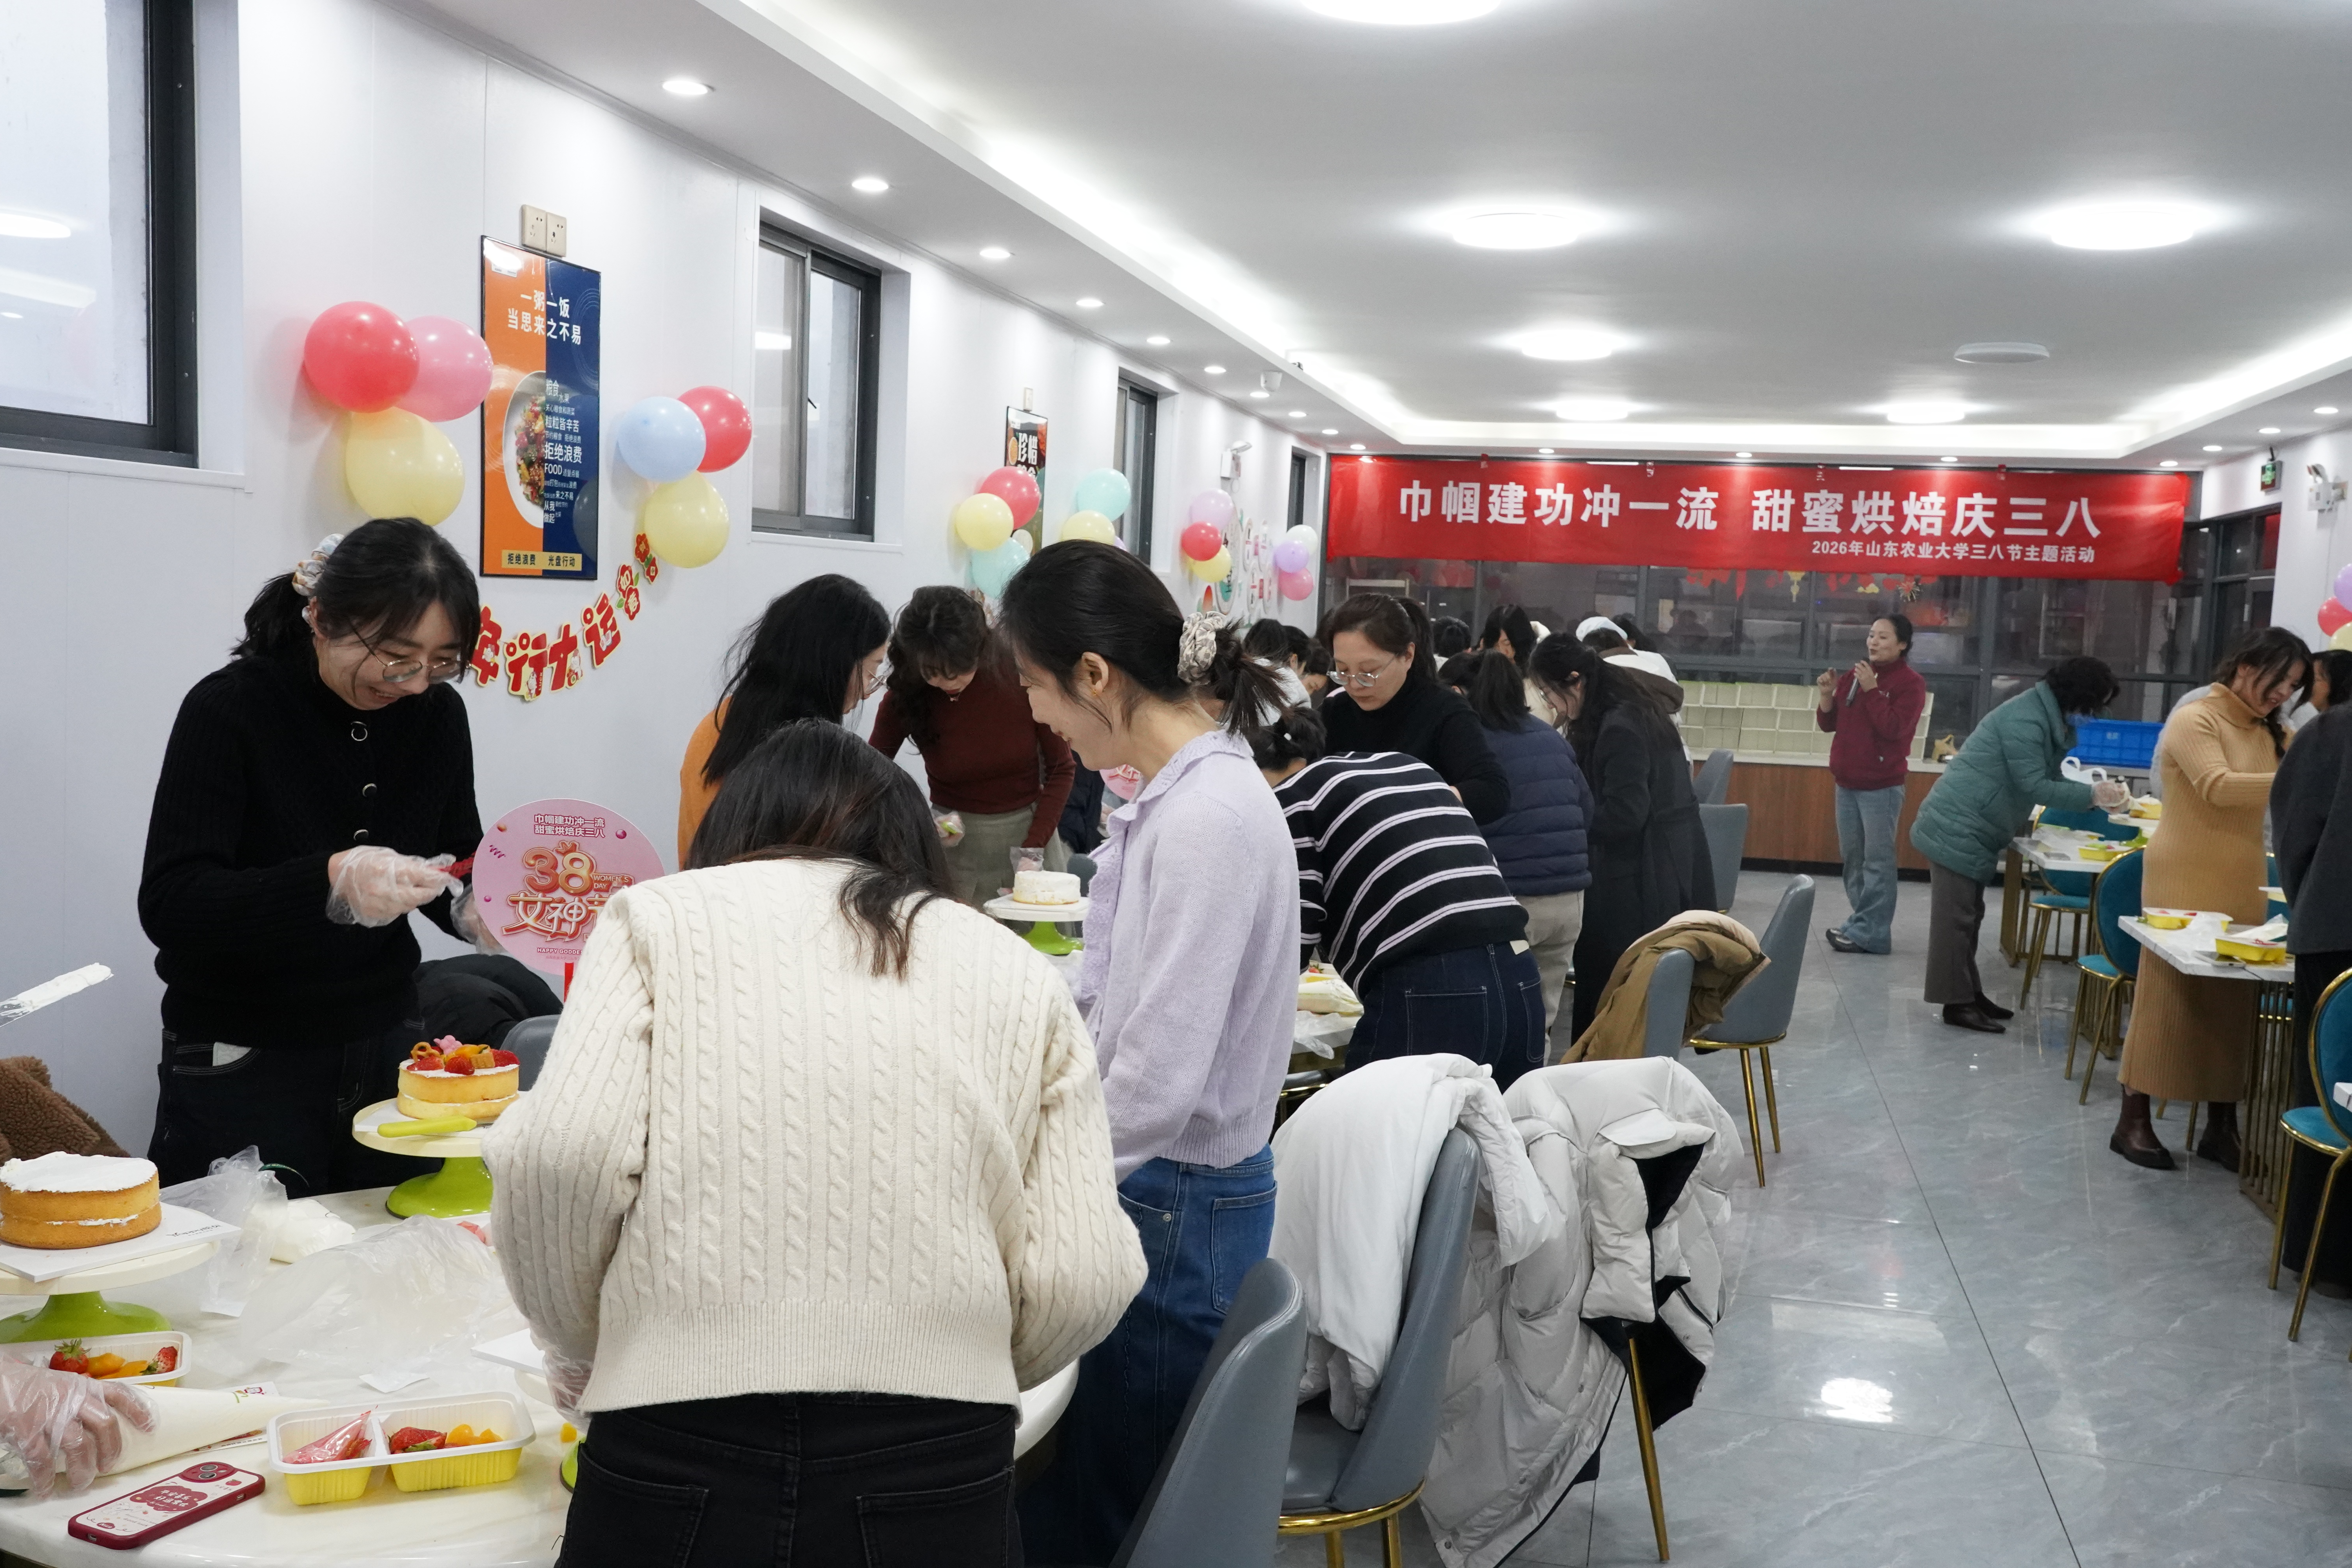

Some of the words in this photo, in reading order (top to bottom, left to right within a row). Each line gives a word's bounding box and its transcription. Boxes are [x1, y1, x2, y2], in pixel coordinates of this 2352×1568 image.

[520, 290, 570, 318] 一粥一饭
[508, 308, 581, 345] 当思来之不易
[545, 415, 579, 433] 粒粒皆辛苦
[544, 442, 582, 464] 拒绝浪费
[1017, 432, 1038, 465] 珍惜
[544, 463, 563, 475] FOOD
[544, 500, 555, 511] 从我
[1400, 479, 1719, 530] 巾帼建功冲一流
[1751, 488, 2102, 538] 甜蜜烘焙庆三八
[508, 553, 535, 565] 拒绝浪费
[548, 555, 575, 567] 光盘行动
[1811, 541, 2096, 563] 2026年山东农业大学三八节主题活动
[534, 814, 606, 828] 巾帼建功冲一流
[534, 825, 606, 838] 甜蜜烘焙庆三八
[524, 849, 594, 896] 38
